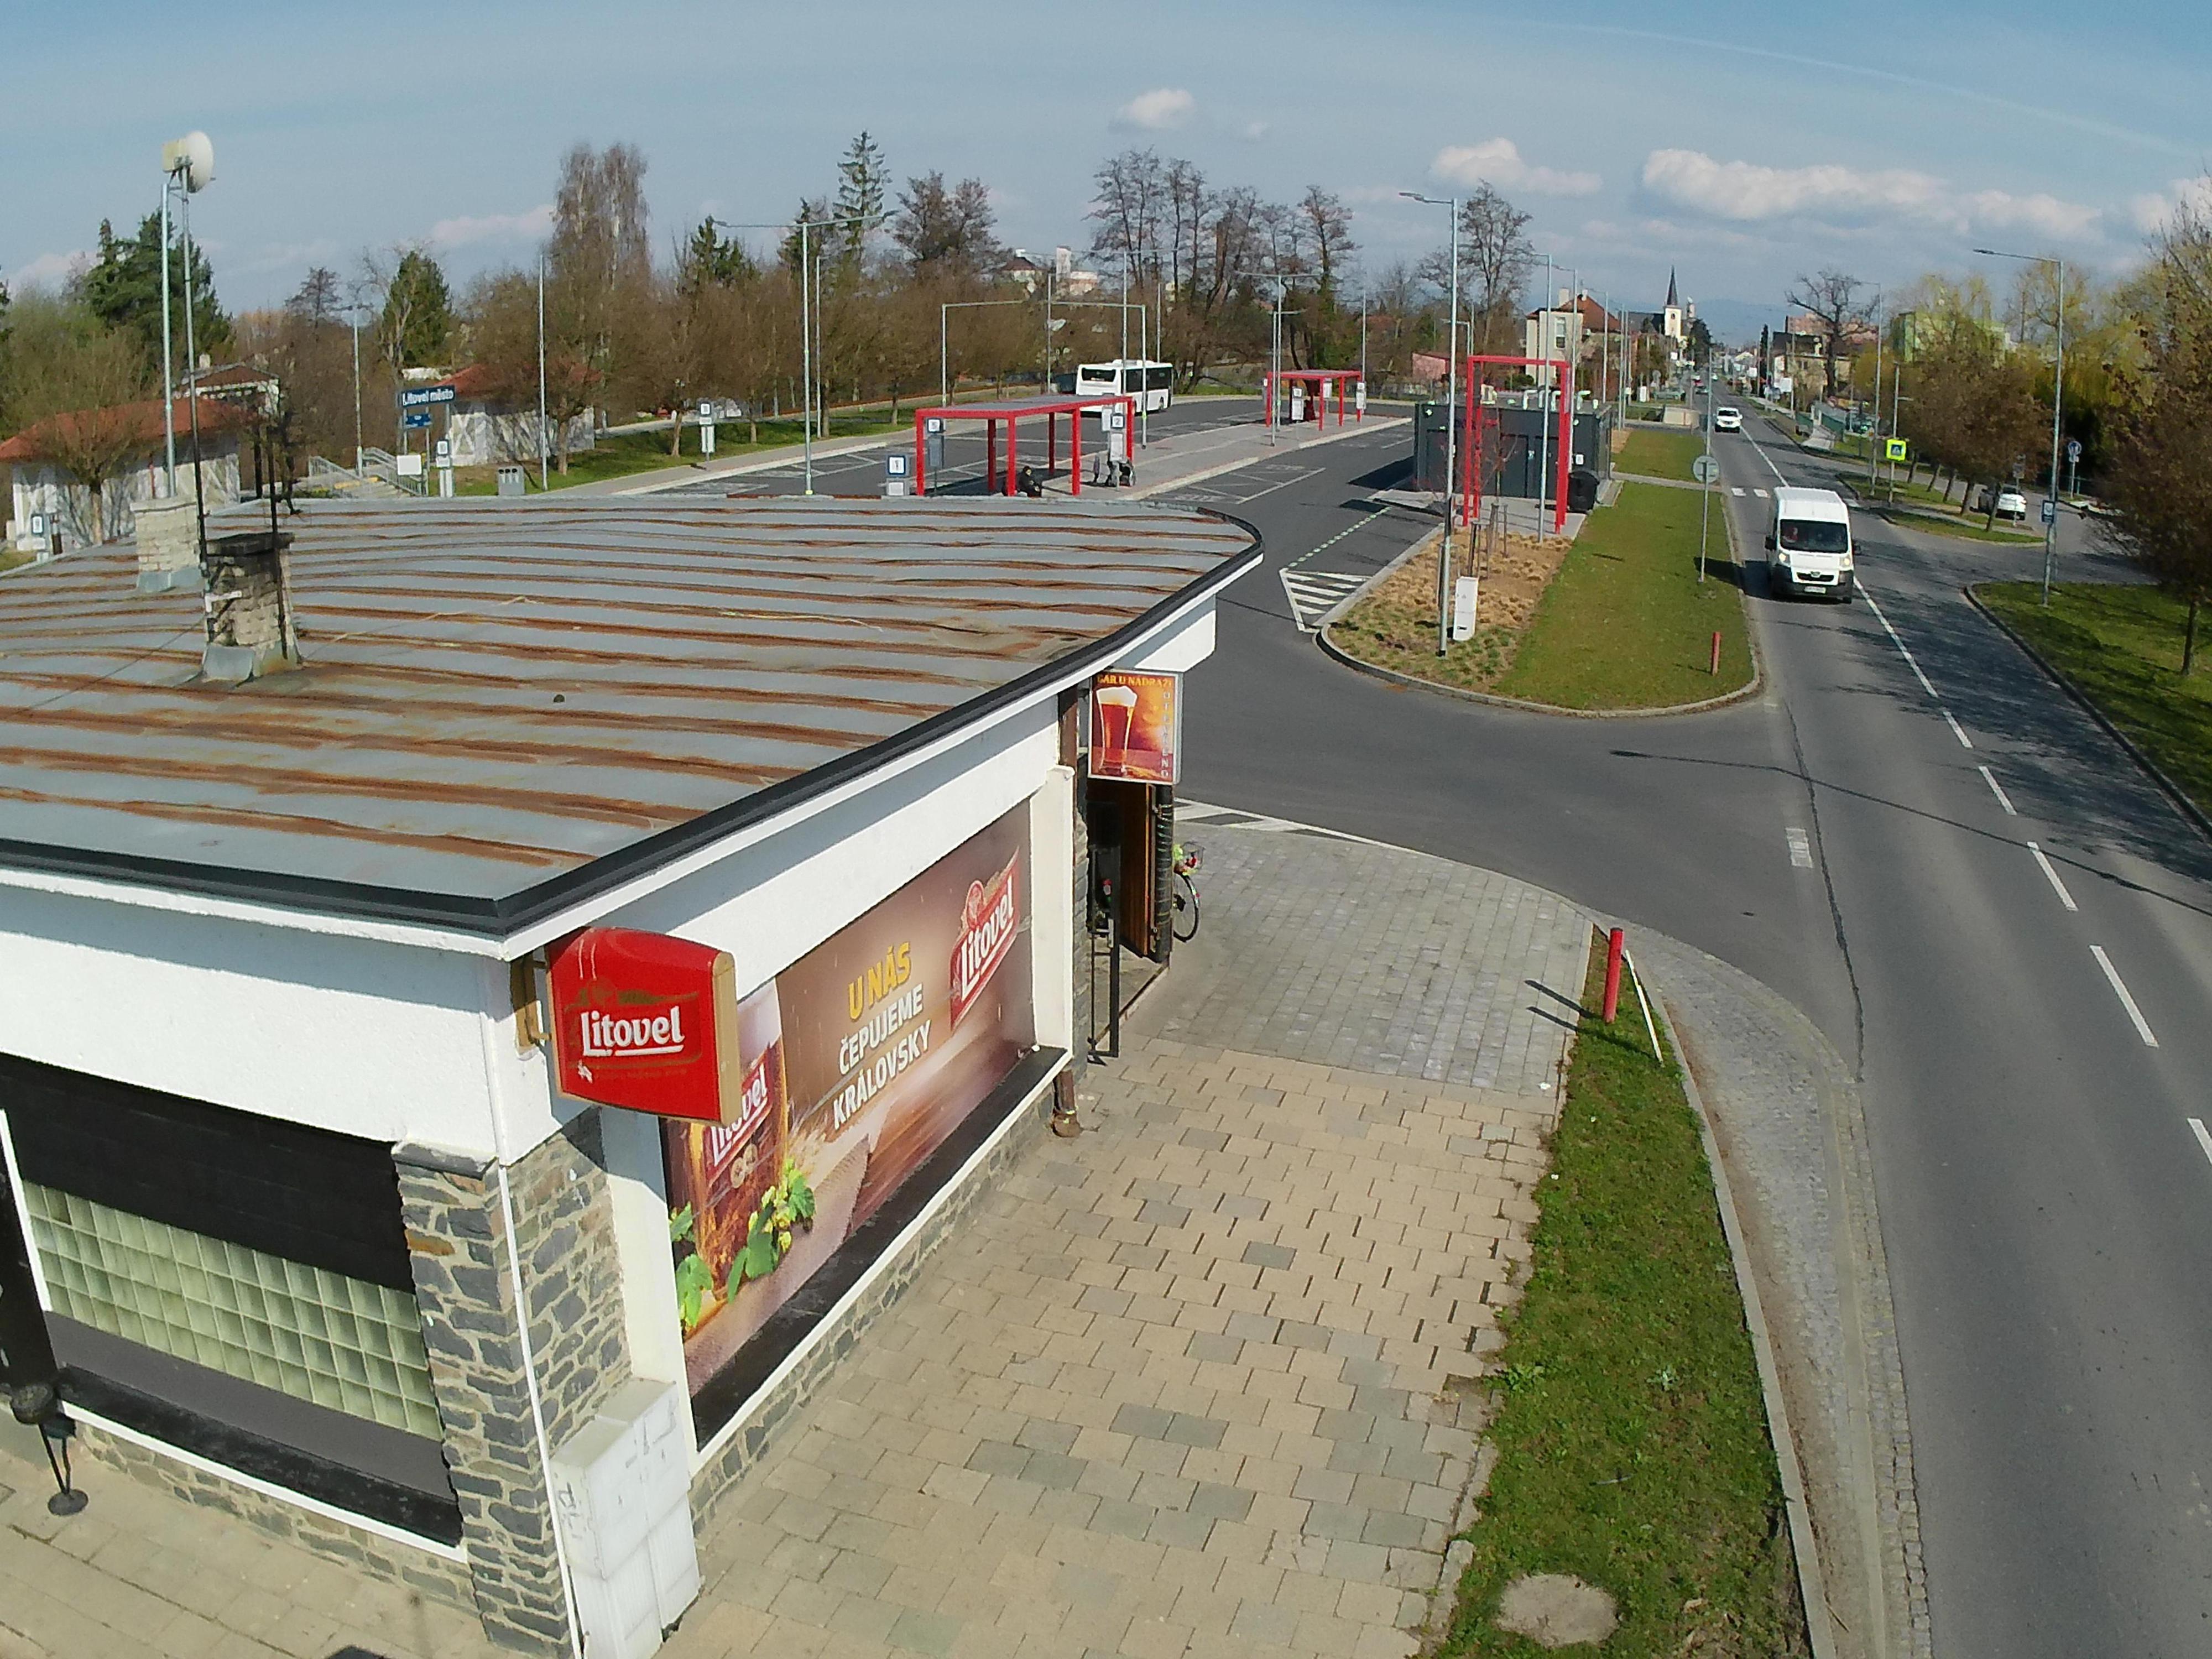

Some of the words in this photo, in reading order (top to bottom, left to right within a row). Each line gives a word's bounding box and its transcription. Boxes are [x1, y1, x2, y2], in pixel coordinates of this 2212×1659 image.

[1119, 676, 1126, 685] U
[961, 873, 1014, 1001] Litovel
[848, 975, 864, 1021] U
[868, 942, 911, 1007] NÁS
[581, 1005, 685, 1056] Litovel
[838, 983, 924, 1076] ČEPUJEME
[833, 1020, 931, 1130] KRÁLOVSKY
